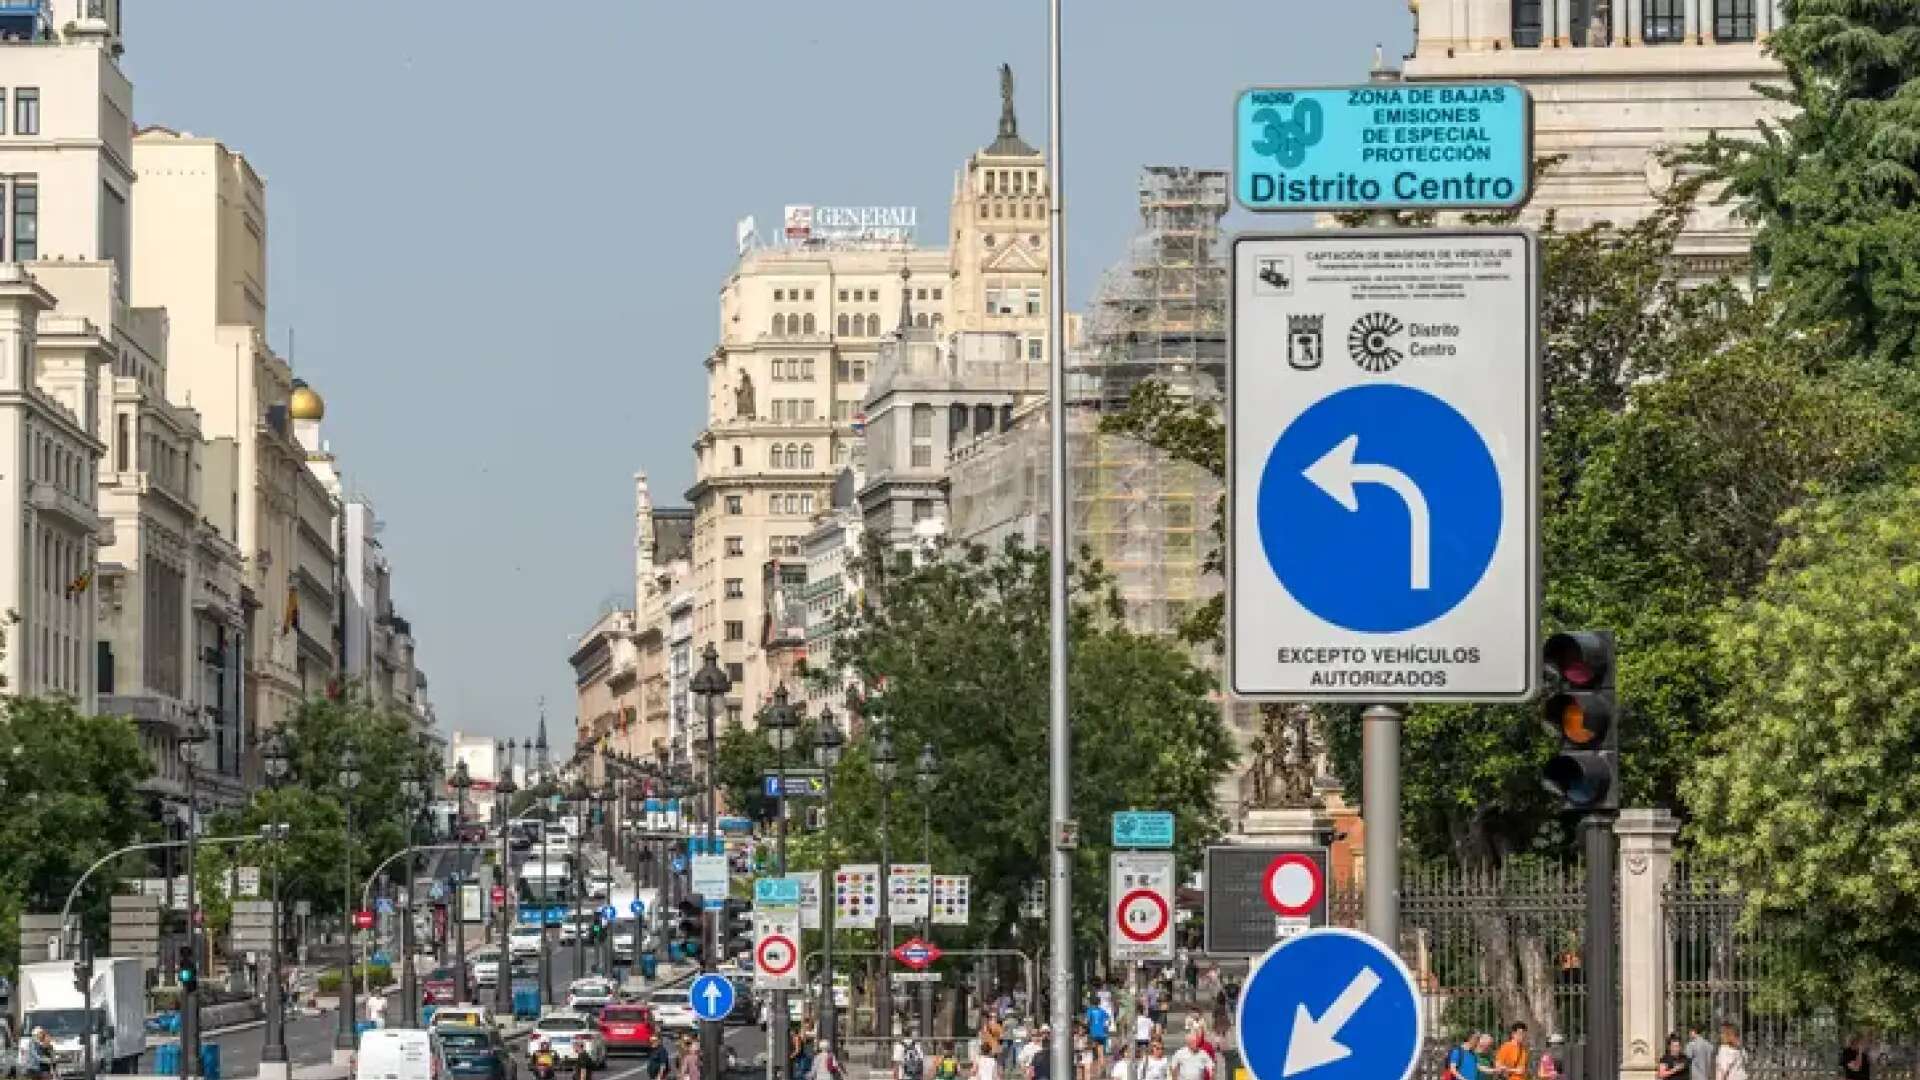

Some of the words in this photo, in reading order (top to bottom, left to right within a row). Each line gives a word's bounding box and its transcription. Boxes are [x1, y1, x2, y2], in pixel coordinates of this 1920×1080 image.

[1347, 89, 1400, 106] ZONA
[1408, 89, 1433, 104] DE
[1440, 88, 1506, 104] BAJAS
[1373, 108, 1481, 124] EMISIONES
[1362, 127, 1388, 144] DE
[1394, 126, 1492, 143] ESPECIAL
[1362, 145, 1491, 162] PROTECCIÓN
[1251, 172, 1380, 202] Distrito
[1394, 171, 1514, 200] Centro
[816, 206, 917, 226] GENERALI
[1409, 322, 1460, 337] Distrito
[1410, 341, 1457, 356] Centro
[1277, 646, 1367, 664] EXCEPTO
[1371, 643, 1481, 664] VEHÍCULOS
[1309, 670, 1448, 687] AUTORIZADOS
